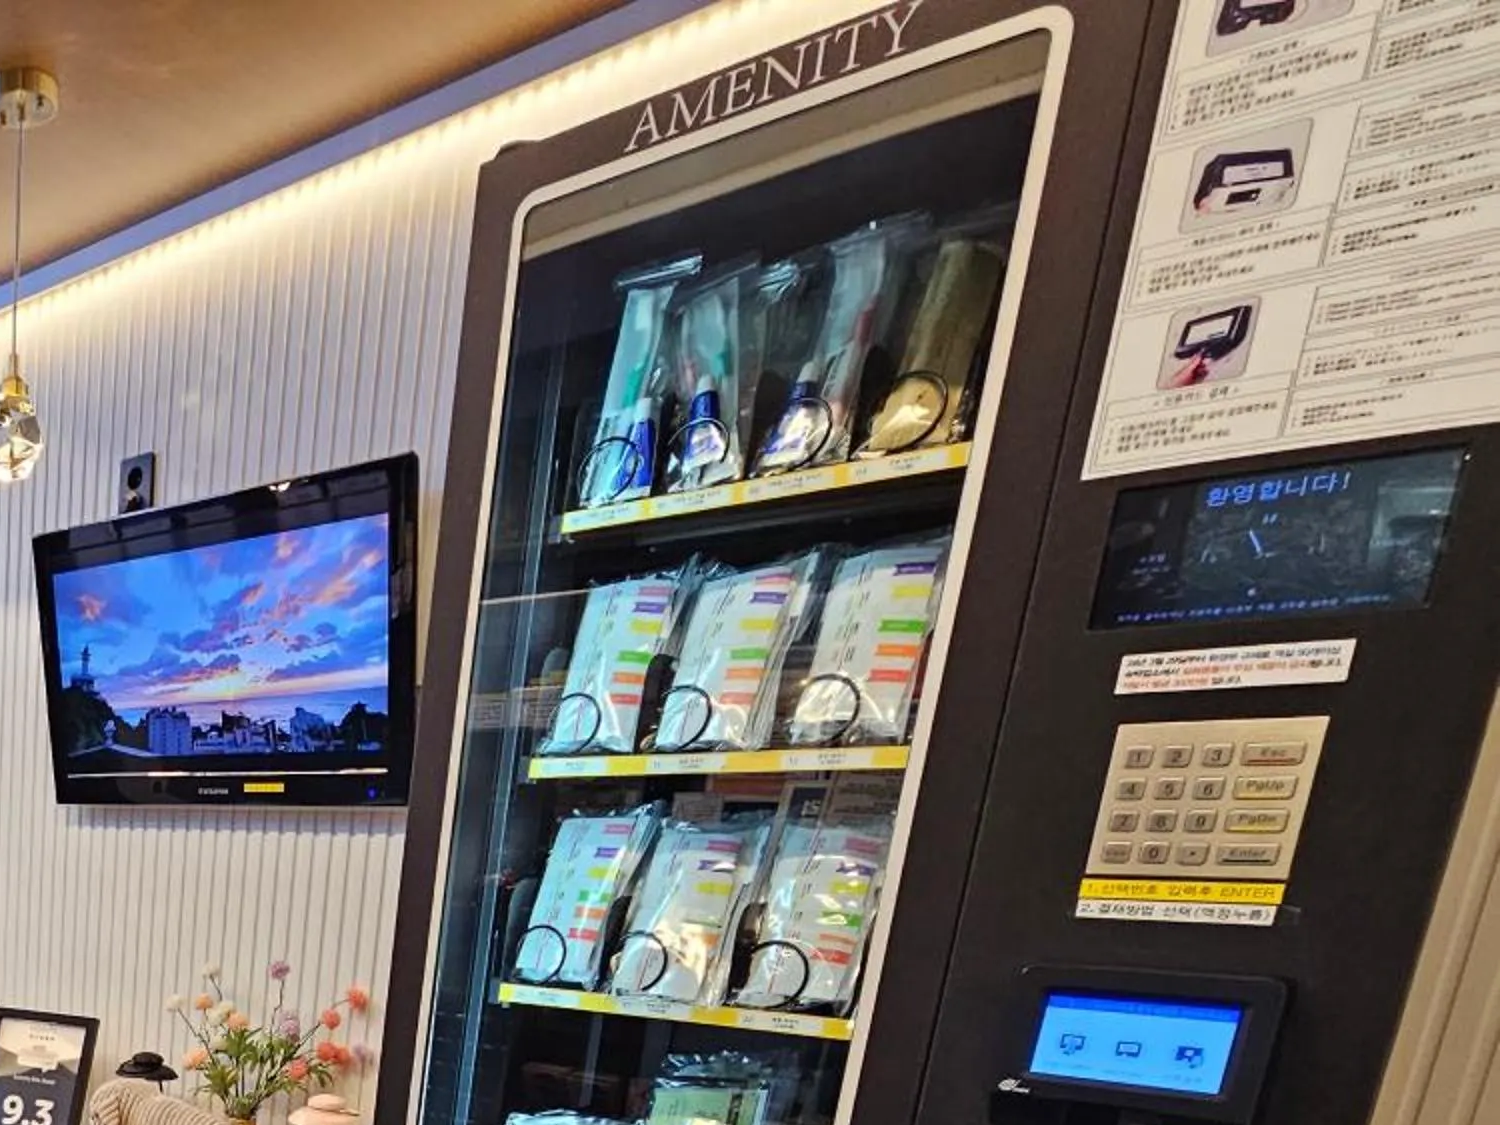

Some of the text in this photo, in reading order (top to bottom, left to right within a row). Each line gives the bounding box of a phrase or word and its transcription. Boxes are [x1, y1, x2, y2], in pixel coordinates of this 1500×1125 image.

[624, 1, 924, 153] AMENITY
[1206, 471, 1351, 507] 환영합니다!
[1220, 885, 1276, 899] ENTER
